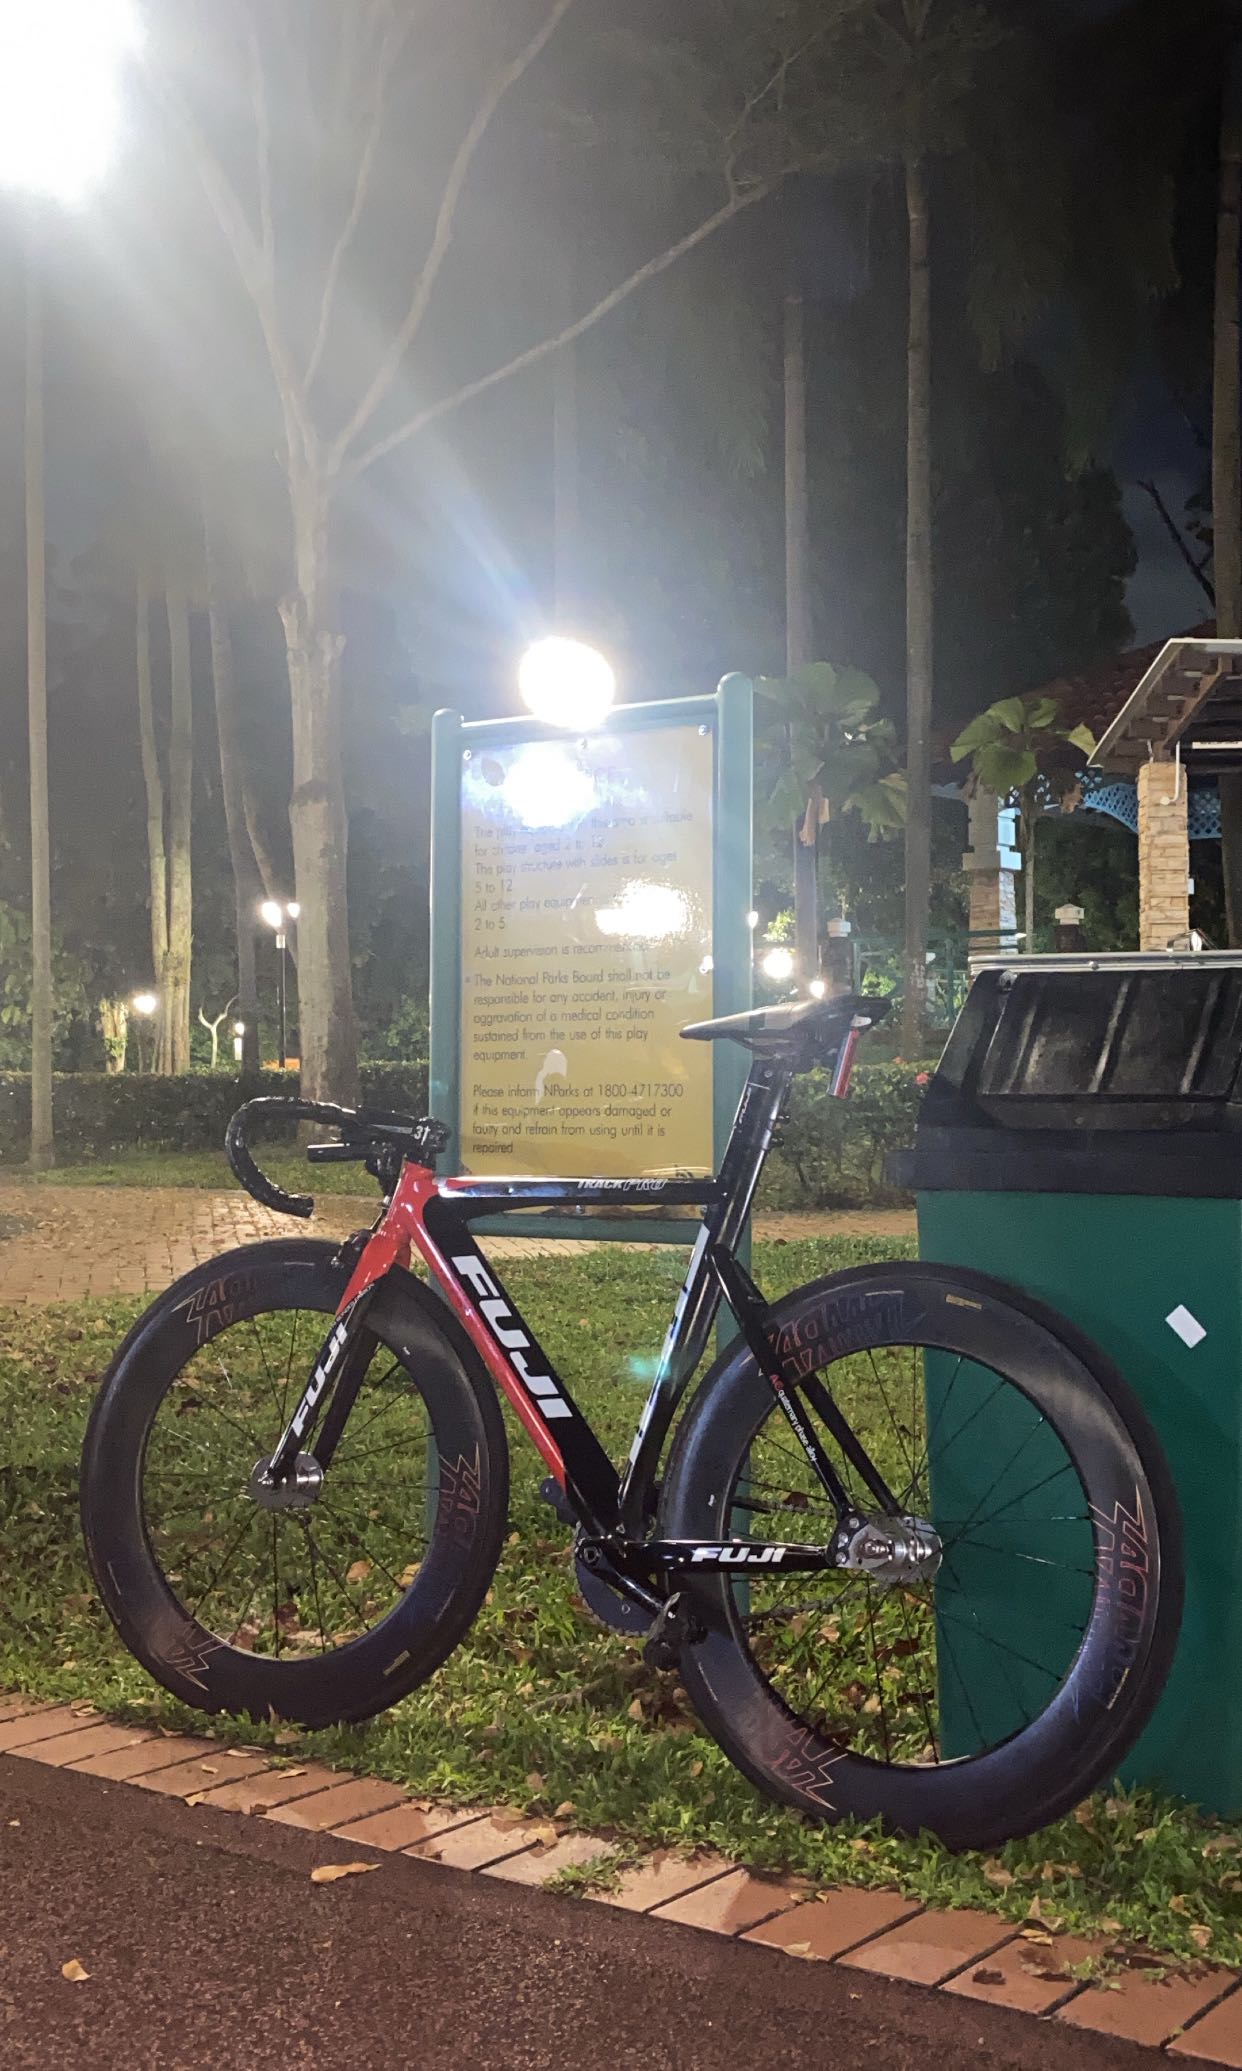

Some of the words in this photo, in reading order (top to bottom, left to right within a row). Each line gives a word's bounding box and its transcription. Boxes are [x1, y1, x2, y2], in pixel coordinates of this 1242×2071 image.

[475, 861, 493, 875] The
[496, 863, 516, 877] play
[565, 856, 586, 869] with
[633, 849, 646, 865] for
[475, 881, 482, 894] 5
[486, 882, 496, 893] to
[502, 878, 513, 892] 12
[474, 899, 487, 912] All
[520, 896, 540, 912] play
[474, 917, 482, 931] 2
[486, 919, 496, 930] to
[498, 916, 506, 930] 5
[474, 944, 499, 959] Adult
[503, 945, 558, 960] supervision
[561, 945, 570, 956] is
[474, 973, 492, 987] The
[496, 971, 539, 986] National
[542, 968, 569, 985] Parks
[572, 968, 604, 983] Board
[607, 967, 632, 982] shall
[635, 969, 653, 981] not
[656, 968, 671, 980] be
[473, 991, 529, 1007] responsible
[532, 989, 546, 1003] for
[549, 992, 568, 1006] any
[622, 988, 651, 1003] injury
[654, 990, 667, 1000] or
[473, 1010, 532, 1027] aggravation
[536, 1008, 547, 1022] of
[550, 1012, 557, 1021] a
[561, 1007, 602, 1021] medical
[605, 1006, 655, 1020] condition
[473, 1028, 519, 1042] sustained
[522, 1027, 546, 1041] from
[549, 1026, 566, 1041] the
[569, 1030, 587, 1041] use
[590, 1026, 601, 1040] of
[605, 1027, 623, 1040] this
[626, 1026, 649, 1042] play
[473, 1084, 504, 1098] Please
[507, 1083, 540, 1097] inform
[543, 1083, 580, 1098] NParks
[583, 1086, 593, 1097] at
[599, 1083, 684, 1098] 1800-4717300
[482, 1103, 498, 1116] this
[502, 1104, 556, 1119] equipment
[558, 1106, 601, 1119] appears
[604, 1103, 656, 1120] damaged
[660, 1106, 673, 1117] or
[472, 1121, 499, 1137] faulty
[502, 1121, 522, 1135] and
[525, 1120, 558, 1136] refrain
[561, 1120, 586, 1136] from
[589, 1123, 617, 1139] using
[621, 1121, 643, 1137] until
[647, 1123, 654, 1137] it
[657, 1123, 667, 1137] is
[451, 1255, 573, 1419] FUJI
[292, 1321, 348, 1438] FUJI
[691, 1547, 787, 1563] FUJI
